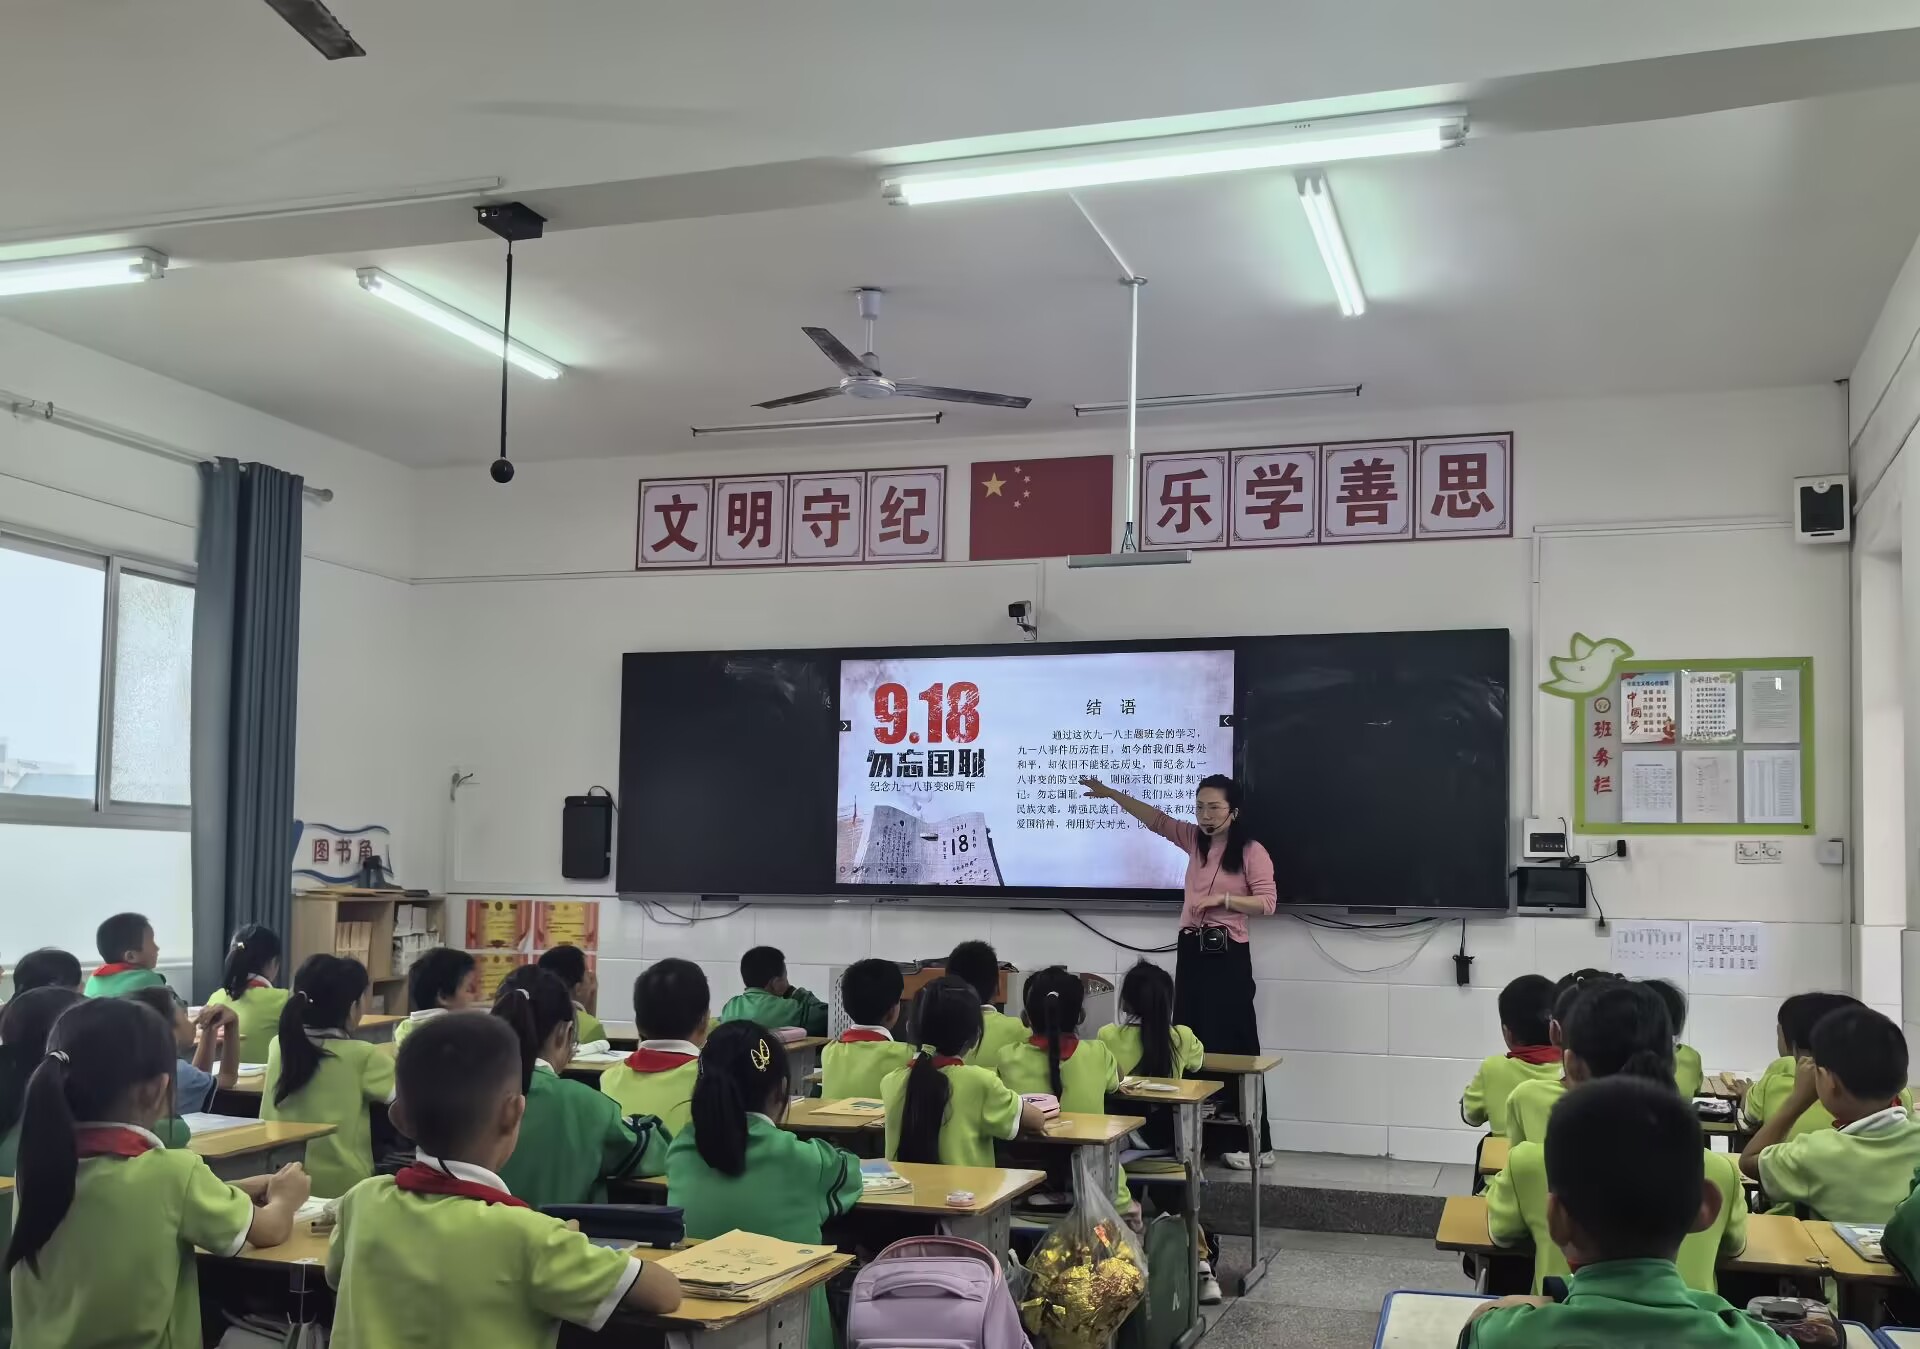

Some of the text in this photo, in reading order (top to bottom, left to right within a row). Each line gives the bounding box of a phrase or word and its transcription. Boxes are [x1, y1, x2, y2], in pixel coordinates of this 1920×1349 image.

[1156, 453, 1496, 534] 乐学善思
[651, 485, 929, 553] 文明守纪
[874, 681, 980, 745] 9.18
[866, 748, 986, 778] 勿忘国耻
[1593, 720, 1613, 795] 班务栏
[870, 780, 976, 793] 纪念九一八事变86周年
[314, 838, 372, 864] 图书角
[952, 834, 969, 856] 18
